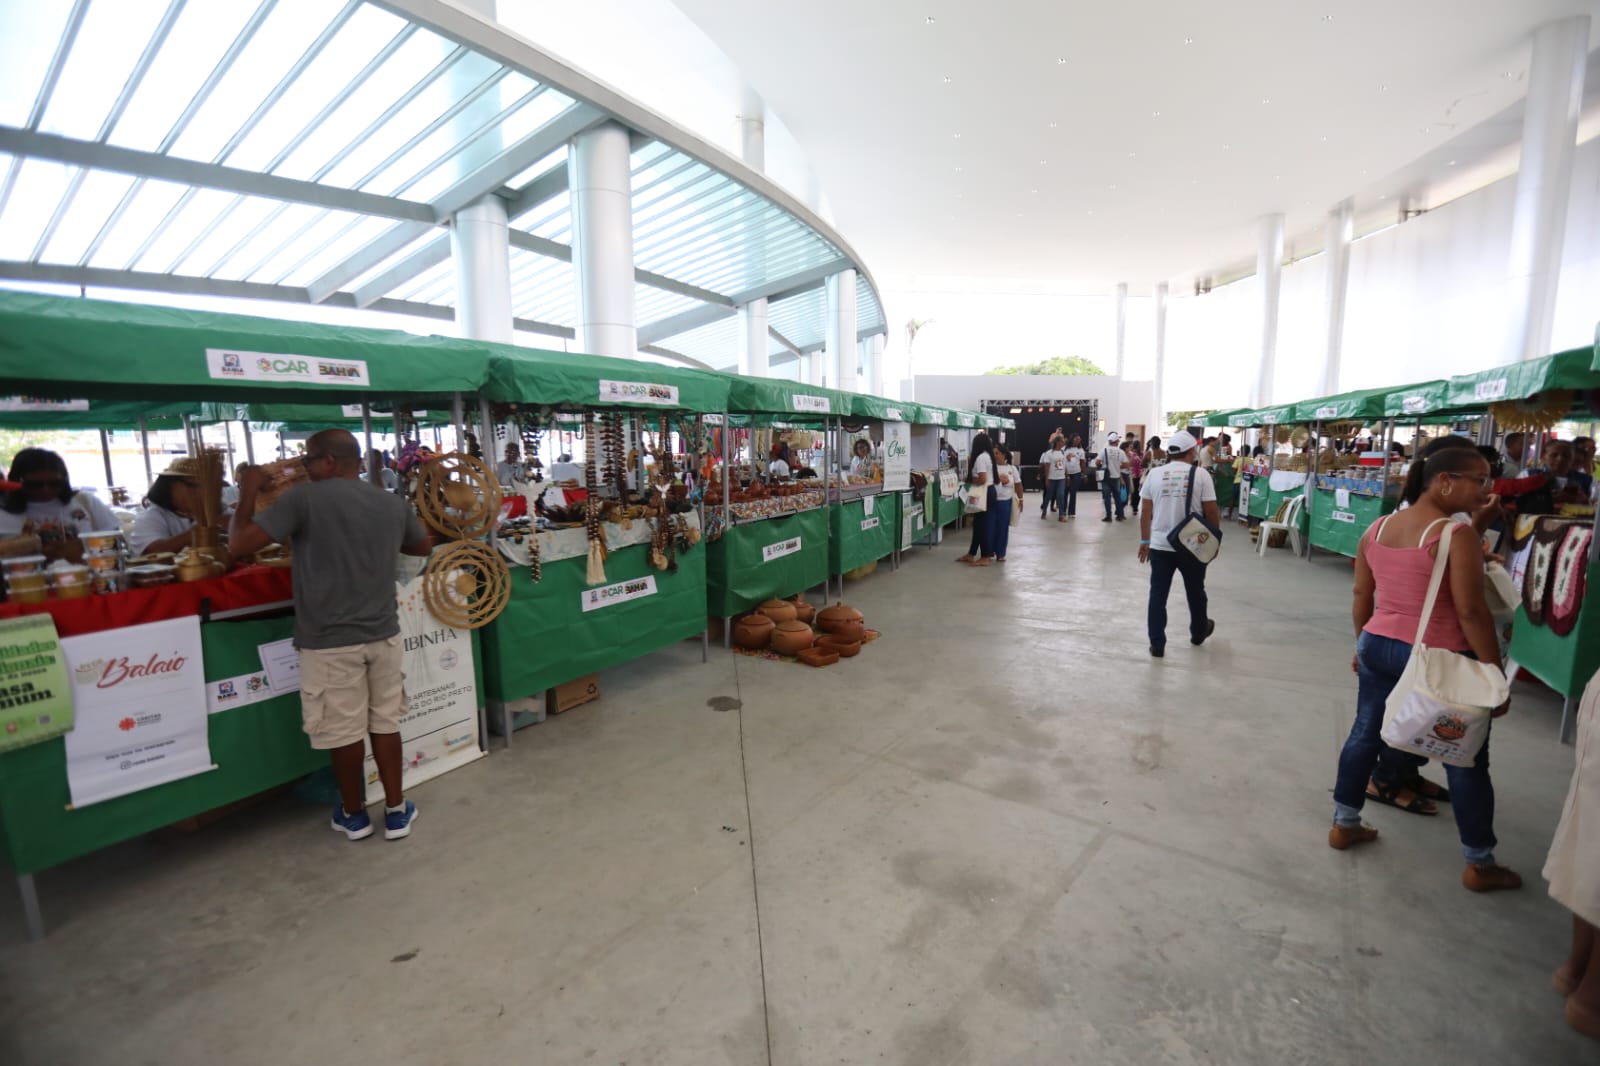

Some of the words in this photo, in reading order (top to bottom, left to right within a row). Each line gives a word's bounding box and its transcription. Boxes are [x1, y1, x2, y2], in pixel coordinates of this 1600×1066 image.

[273, 359, 310, 374] CAR
[318, 365, 360, 378] BAHIA
[608, 585, 624, 597] CAR
[96, 651, 188, 689] Balaio
[421, 699, 432, 708] DO
[448, 685, 473, 697] PRETO
